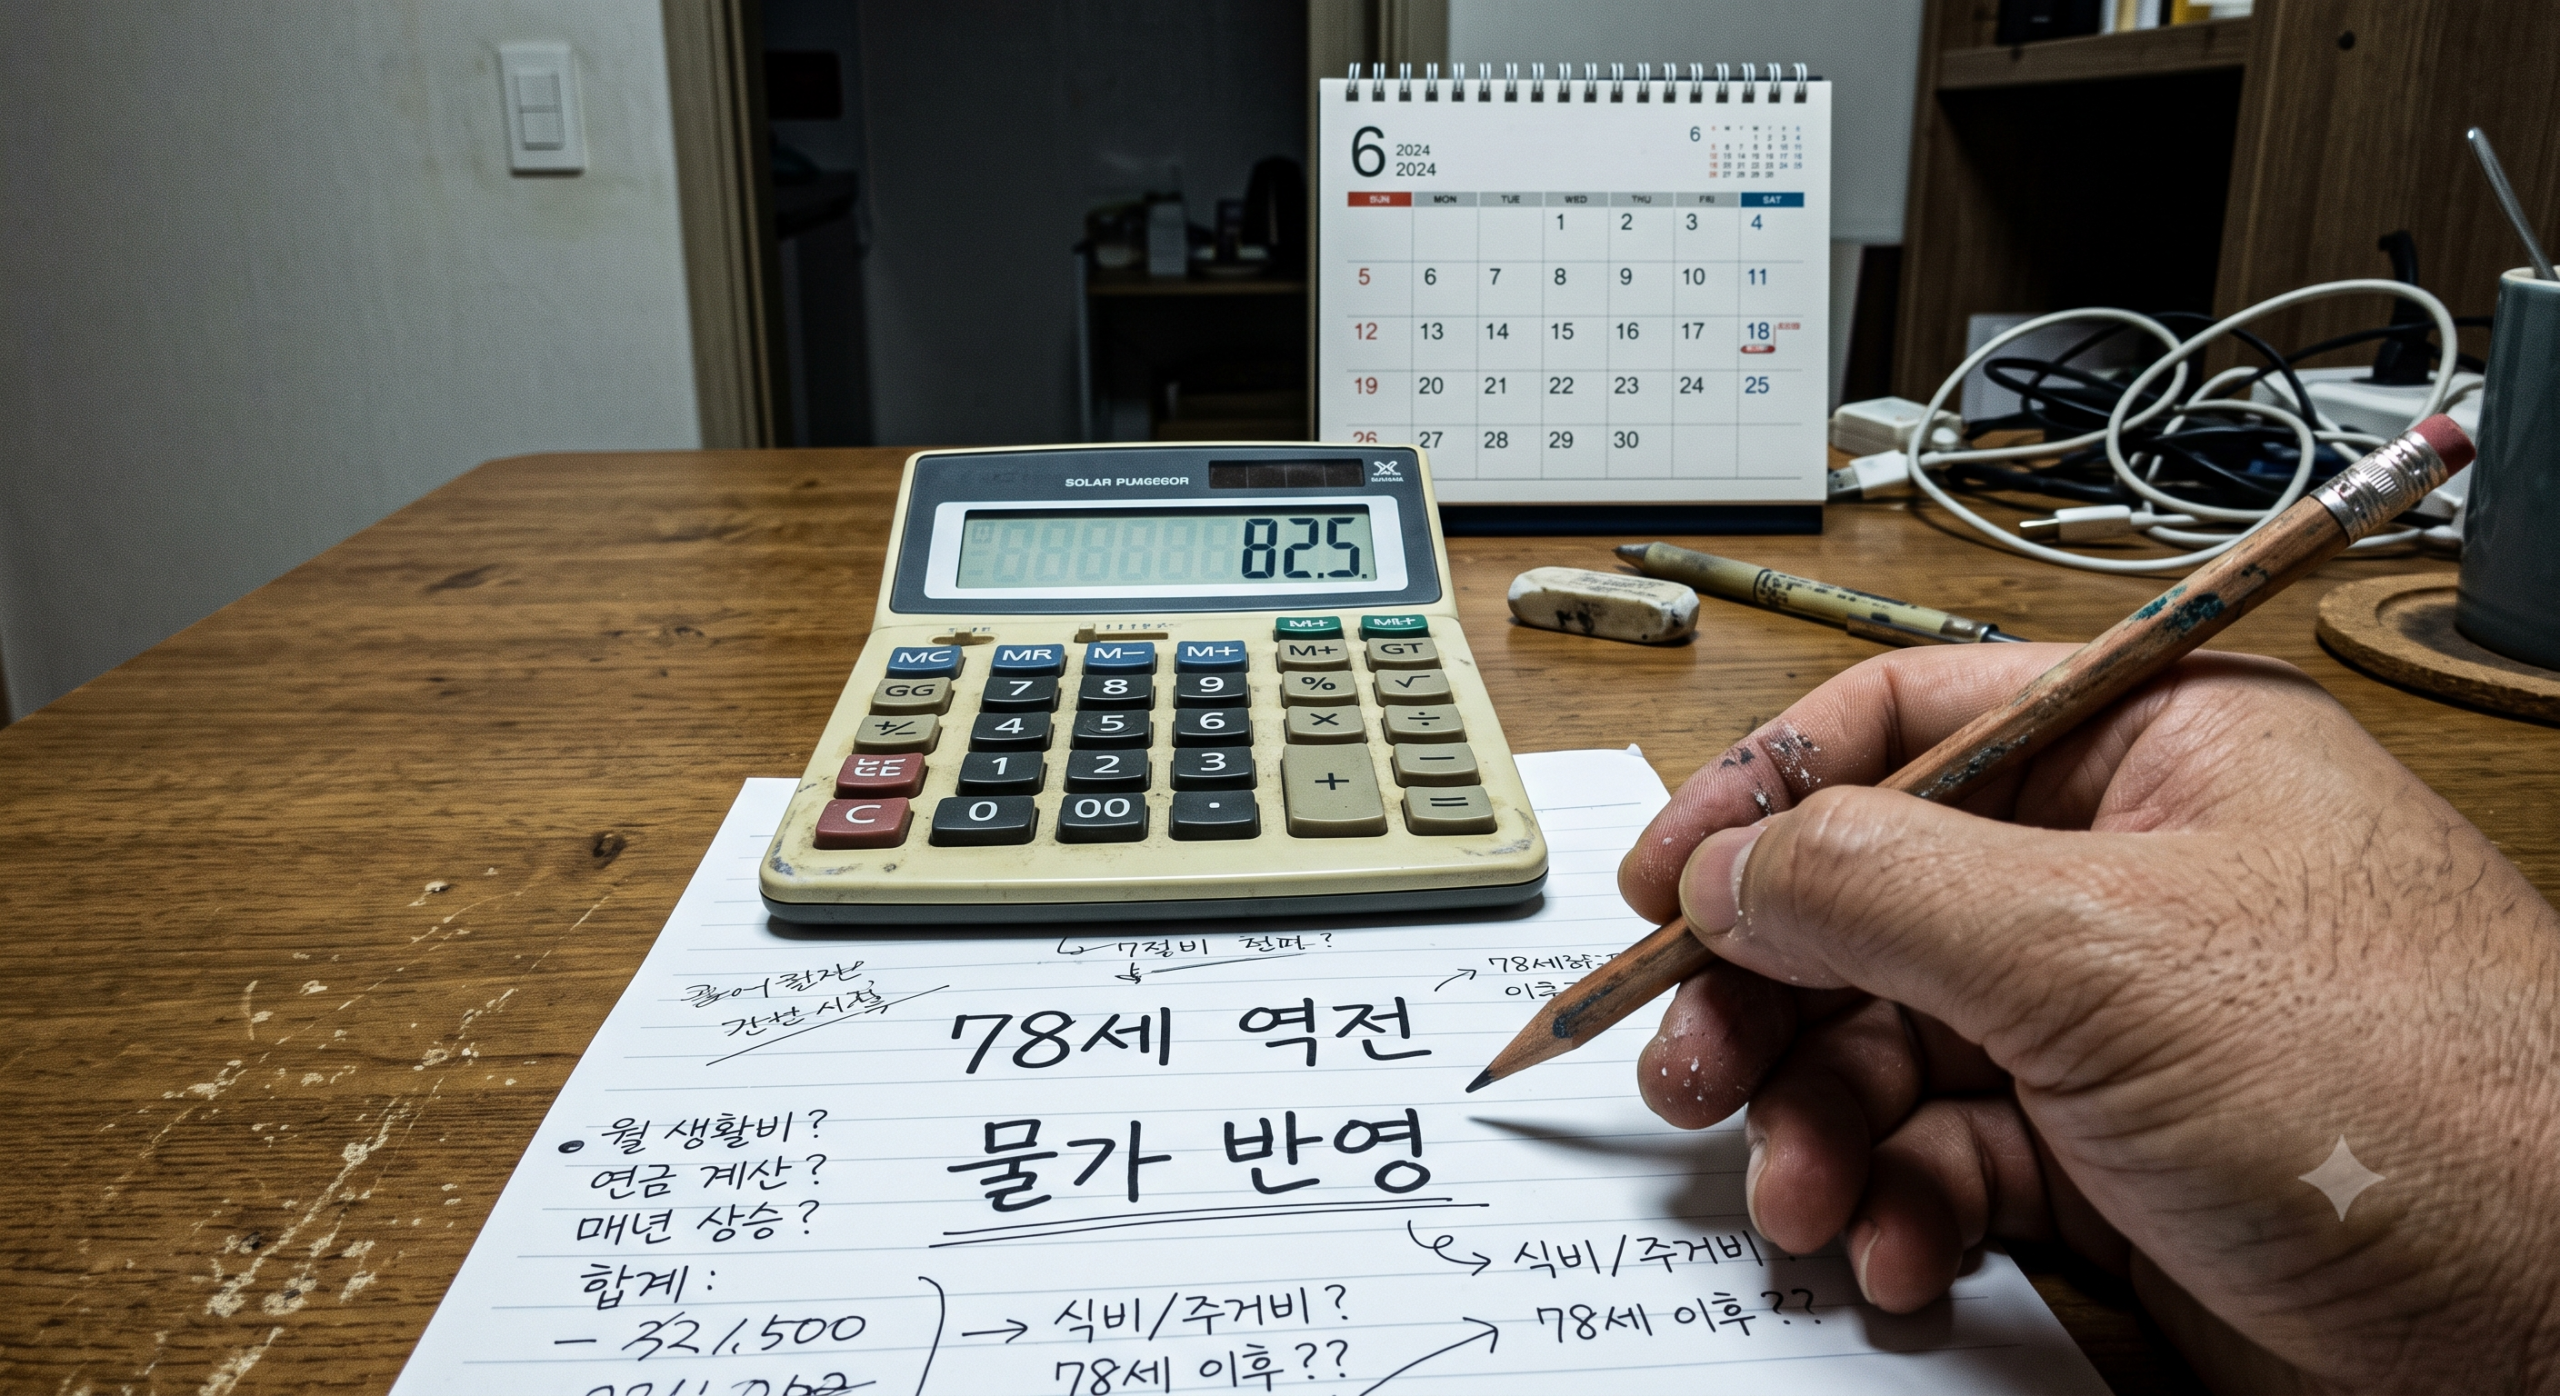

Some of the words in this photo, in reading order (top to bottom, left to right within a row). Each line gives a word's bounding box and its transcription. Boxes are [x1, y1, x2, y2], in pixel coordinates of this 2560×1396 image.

[1690, 126, 1700, 142] 6
[1352, 126, 1385, 177] 6
[1397, 144, 1430, 156] 2024
[1397, 163, 1436, 176] 2024
[1502, 195, 1519, 203] TUE
[1558, 214, 1563, 229] 1
[1622, 213, 1632, 230] 2
[1687, 213, 1697, 230] 3
[1751, 215, 1762, 229] 4
[1359, 268, 1370, 285] 5
[1425, 268, 1436, 285] 6
[1490, 268, 1501, 285] 7
[1555, 268, 1566, 285] 8
[1620, 268, 1632, 285] 9
[1684, 268, 1705, 285] 10
[1749, 269, 1765, 284] 11
[1356, 323, 1377, 339] 12
[1421, 323, 1443, 340] 13
[1487, 323, 1508, 339] 14
[1552, 323, 1573, 340] 15
[1617, 323, 1639, 339] 16
[1683, 323, 1704, 339] 17
[1748, 322, 1769, 340] 18
[1356, 377, 1377, 394] 19
[1419, 377, 1443, 394] 20
[1485, 377, 1505, 394] 21
[1550, 377, 1573, 394] 22
[1615, 377, 1638, 394] 23
[1680, 377, 1703, 393] 24
[1745, 377, 1769, 393] 25
[1419, 431, 1443, 448] 27
[1485, 431, 1508, 448] 28
[1550, 432, 1573, 448] 29
[1614, 431, 1639, 448] 30
[899, 651, 951, 663] MC
[1003, 650, 1051, 660] MR
[1188, 646, 1238, 656] M+
[1290, 645, 1337, 656] M+
[1381, 643, 1423, 654] GT
[1010, 681, 1032, 695] 7
[1103, 679, 1127, 694] 8
[1200, 677, 1223, 692] 9
[995, 718, 1024, 733] 4
[1101, 715, 1124, 731] 5
[1200, 713, 1225, 729] 6
[993, 757, 1007, 774] 1
[1094, 755, 1119, 773] 2
[1201, 753, 1226, 770] 3
[846, 805, 881, 823] C
[969, 802, 997, 821] 0
[1075, 798, 1130, 818] 00
[952, 1007, 1170, 1074] 78세
[1239, 997, 1432, 1066] 역전
[602, 1118, 650, 1154] 월
[947, 1119, 1172, 1211] 물가
[1224, 1108, 1430, 1194] 반영
[591, 1165, 676, 1199] 연금
[577, 1209, 672, 1245] 매년
[1514, 1230, 1796, 1278] 식비/주거비
[1537, 1304, 1652, 1343] 78세
[1056, 1357, 1169, 1396] 78세
